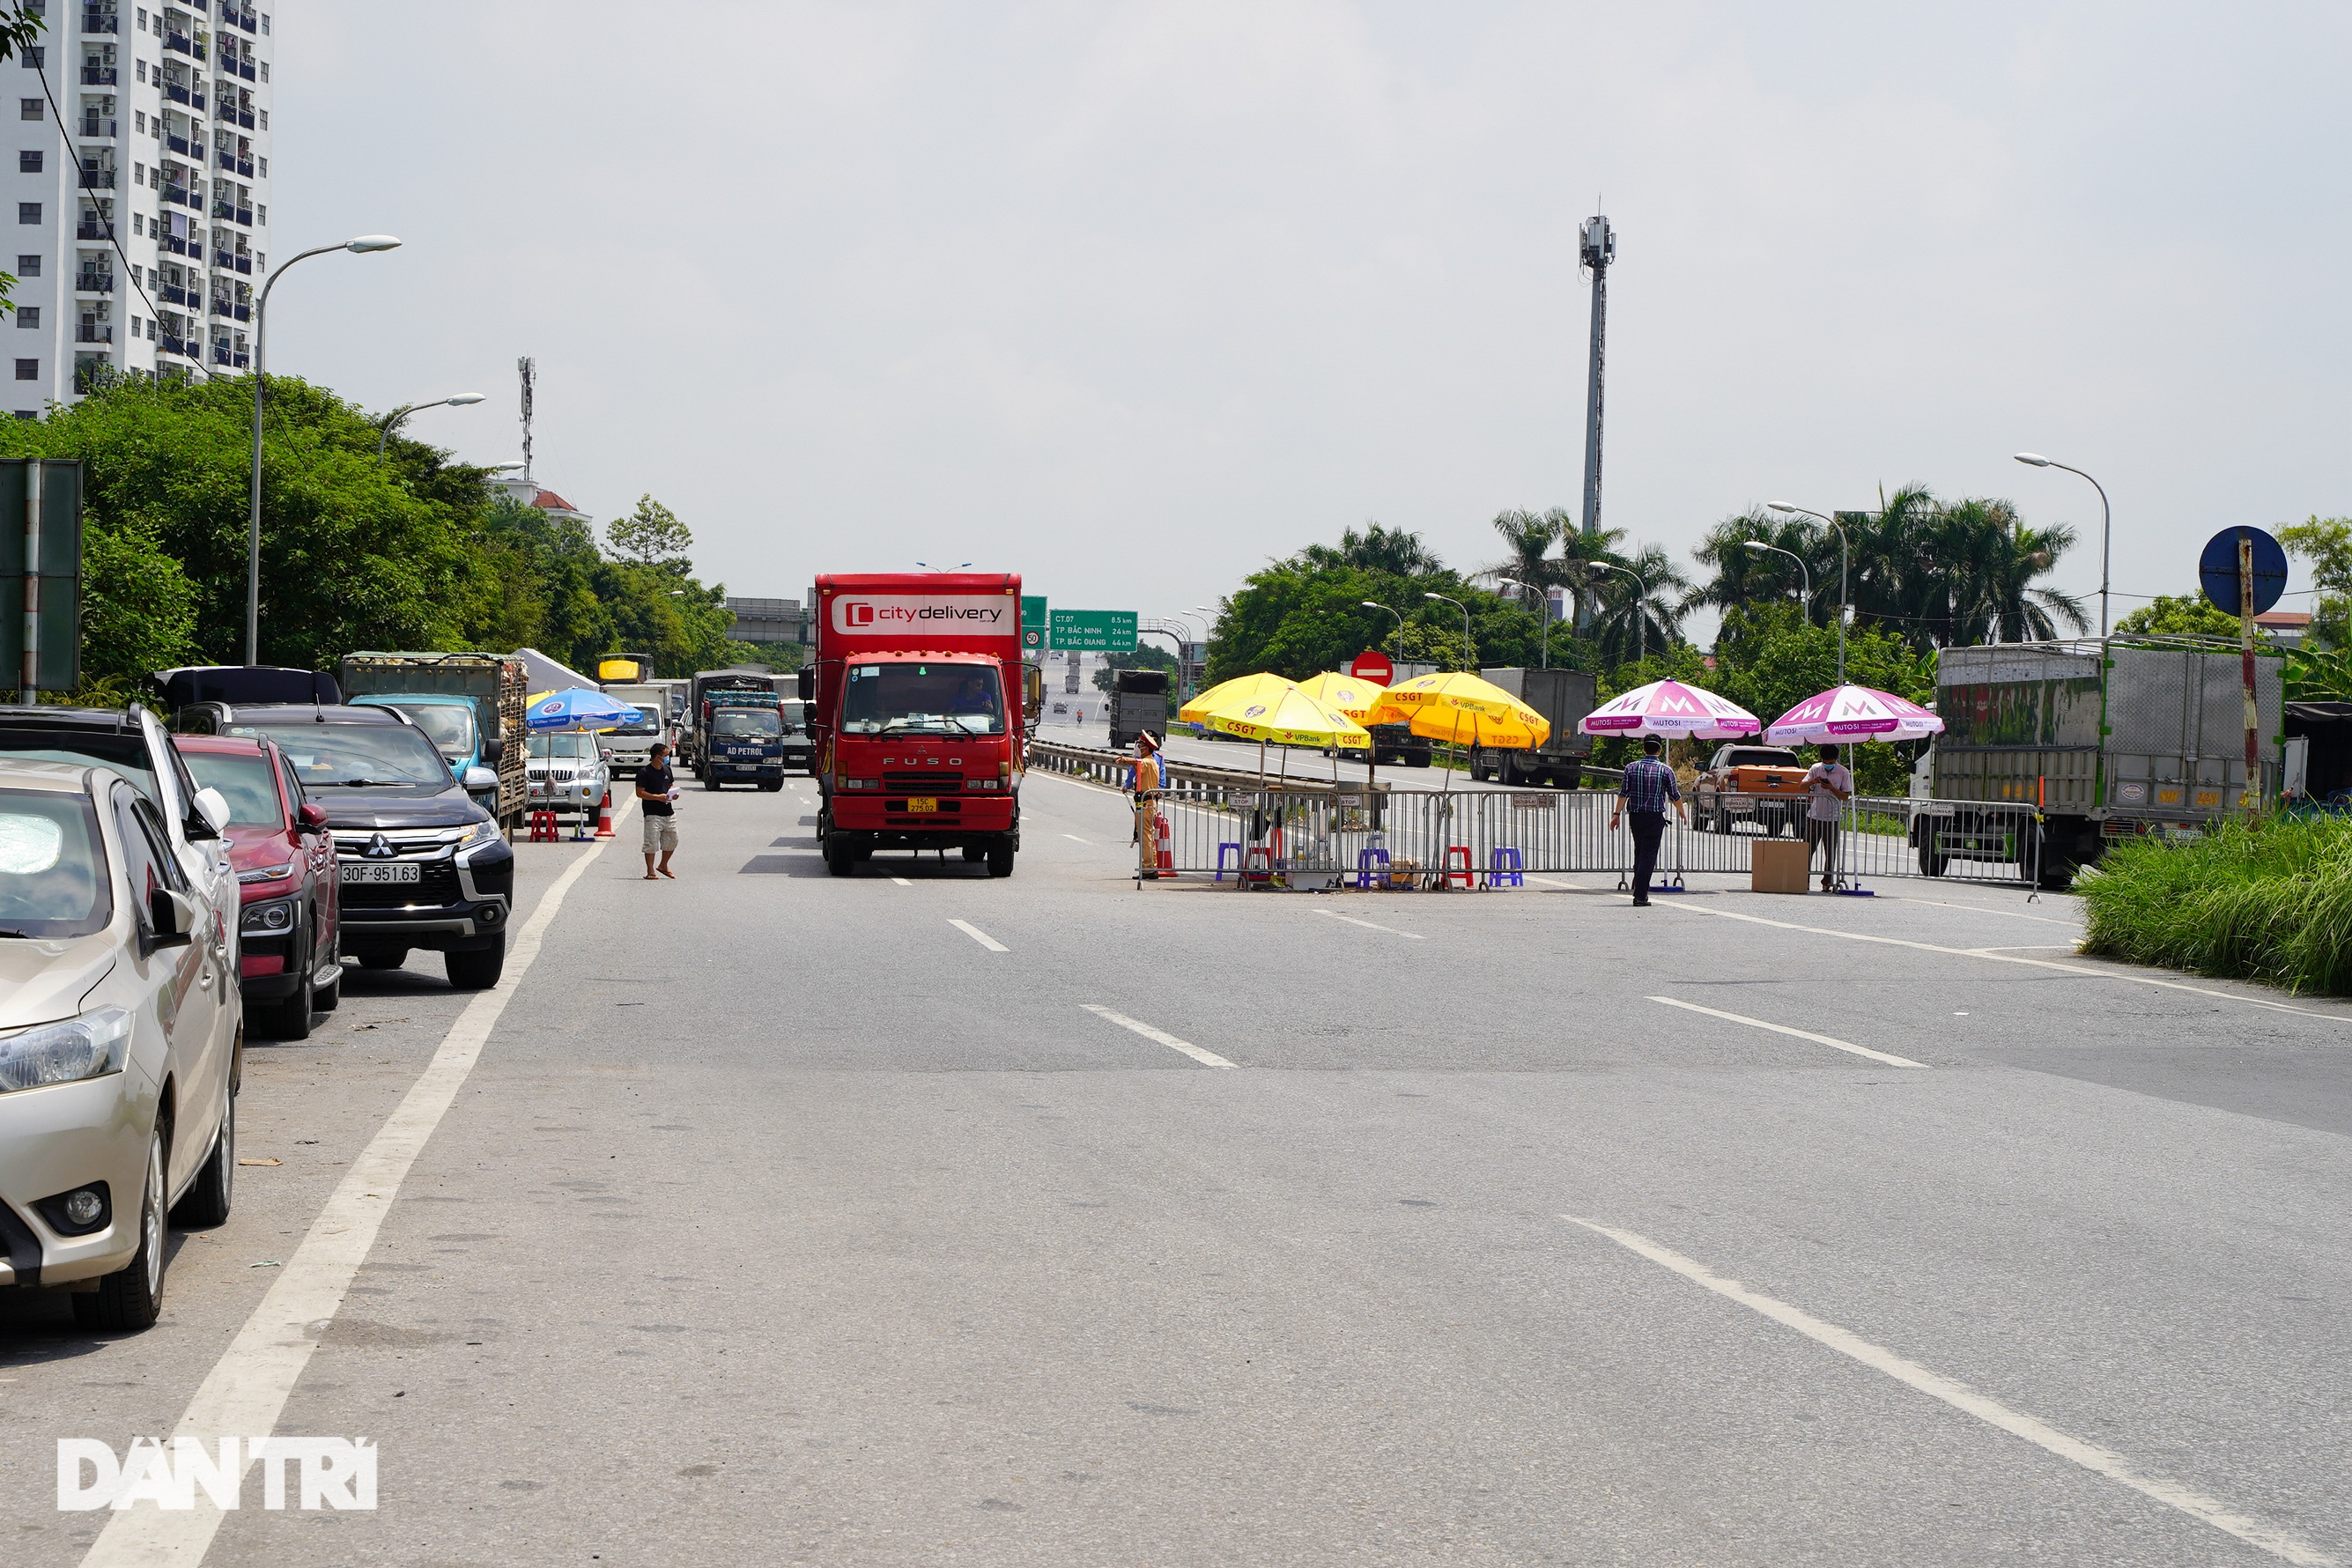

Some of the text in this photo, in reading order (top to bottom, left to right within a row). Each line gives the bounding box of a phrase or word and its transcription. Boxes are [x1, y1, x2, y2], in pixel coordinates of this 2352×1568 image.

[1395, 692, 1424, 701] CSGT
[1460, 701, 1486, 713] VPBank
[1338, 709, 1366, 719] SGT
[1519, 711, 1539, 726] CSGT
[1227, 721, 1257, 735] CSGT
[1295, 733, 1321, 743] VPBank
[1342, 736, 1362, 744] CSGT
[738, 747, 764, 756] PETROL
[343, 867, 418, 881] 30F-951.63
